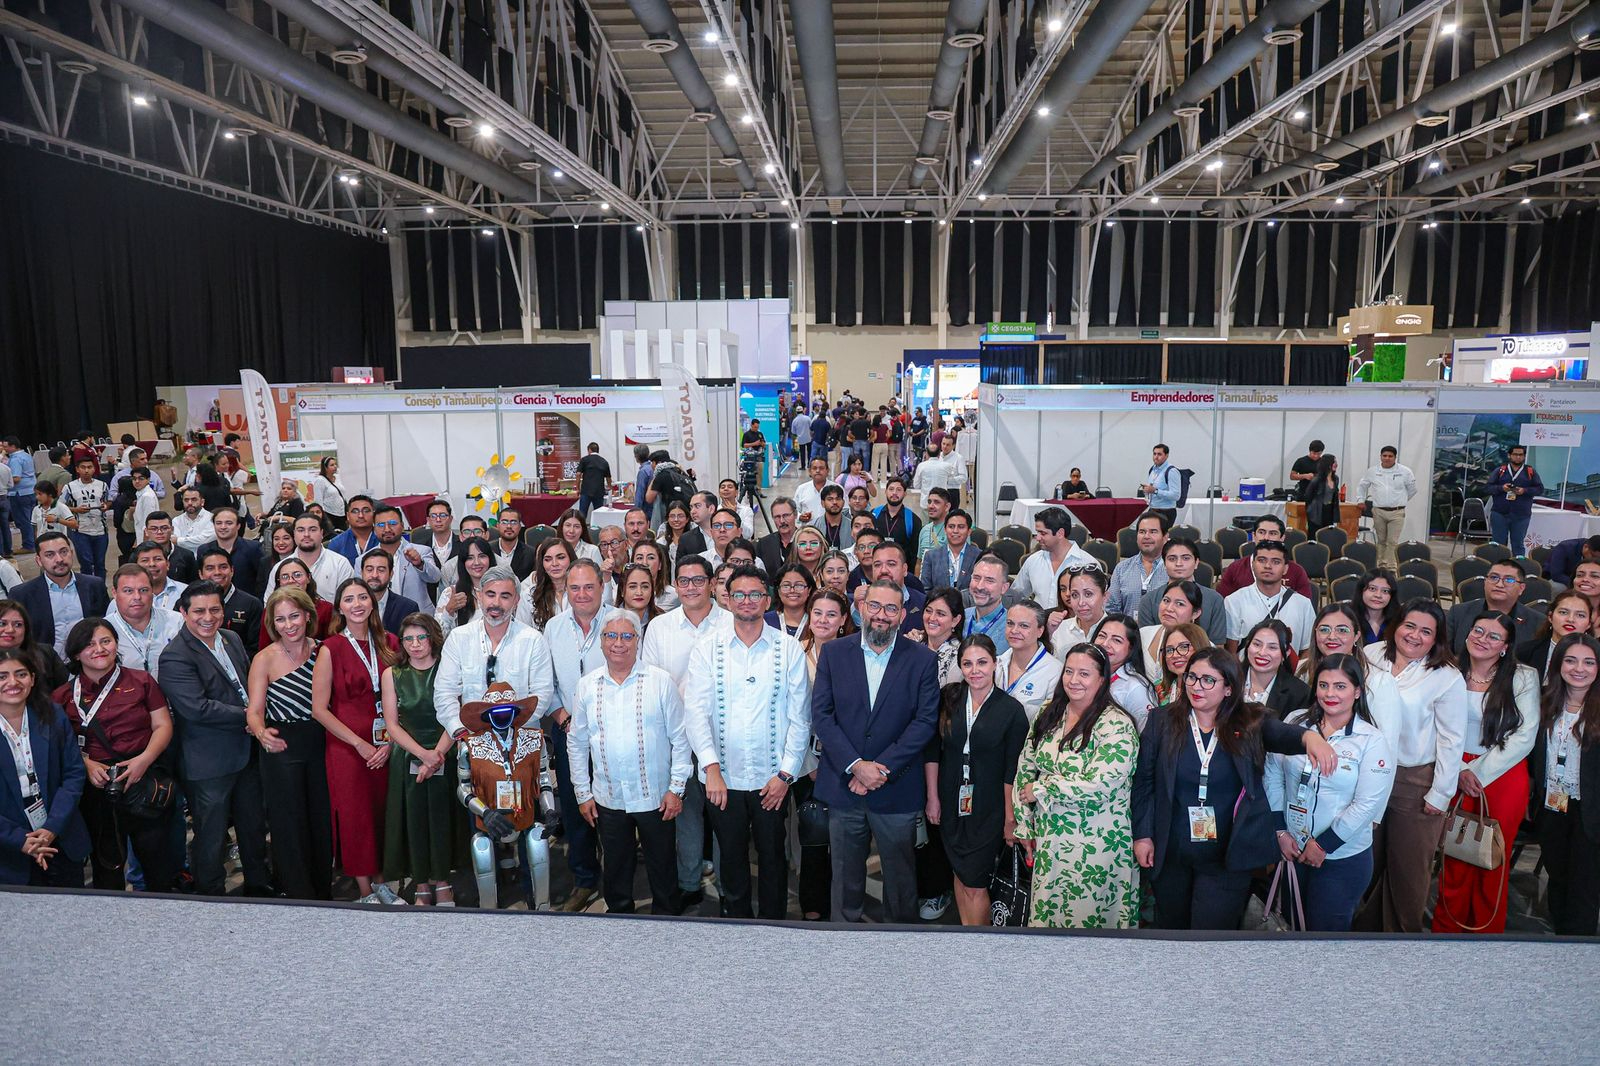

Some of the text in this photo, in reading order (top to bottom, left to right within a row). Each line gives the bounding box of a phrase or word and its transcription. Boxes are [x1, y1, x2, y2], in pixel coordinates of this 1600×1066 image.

[1001, 325, 1034, 333] CEGISTAM
[404, 393, 441, 408] Consejo
[504, 397, 513, 405] de
[513, 393, 547, 405] Ciencia
[548, 398, 553, 407] y
[554, 393, 606, 407] Tecnología
[1131, 391, 1278, 405] Emprendedores Tamaulipas
